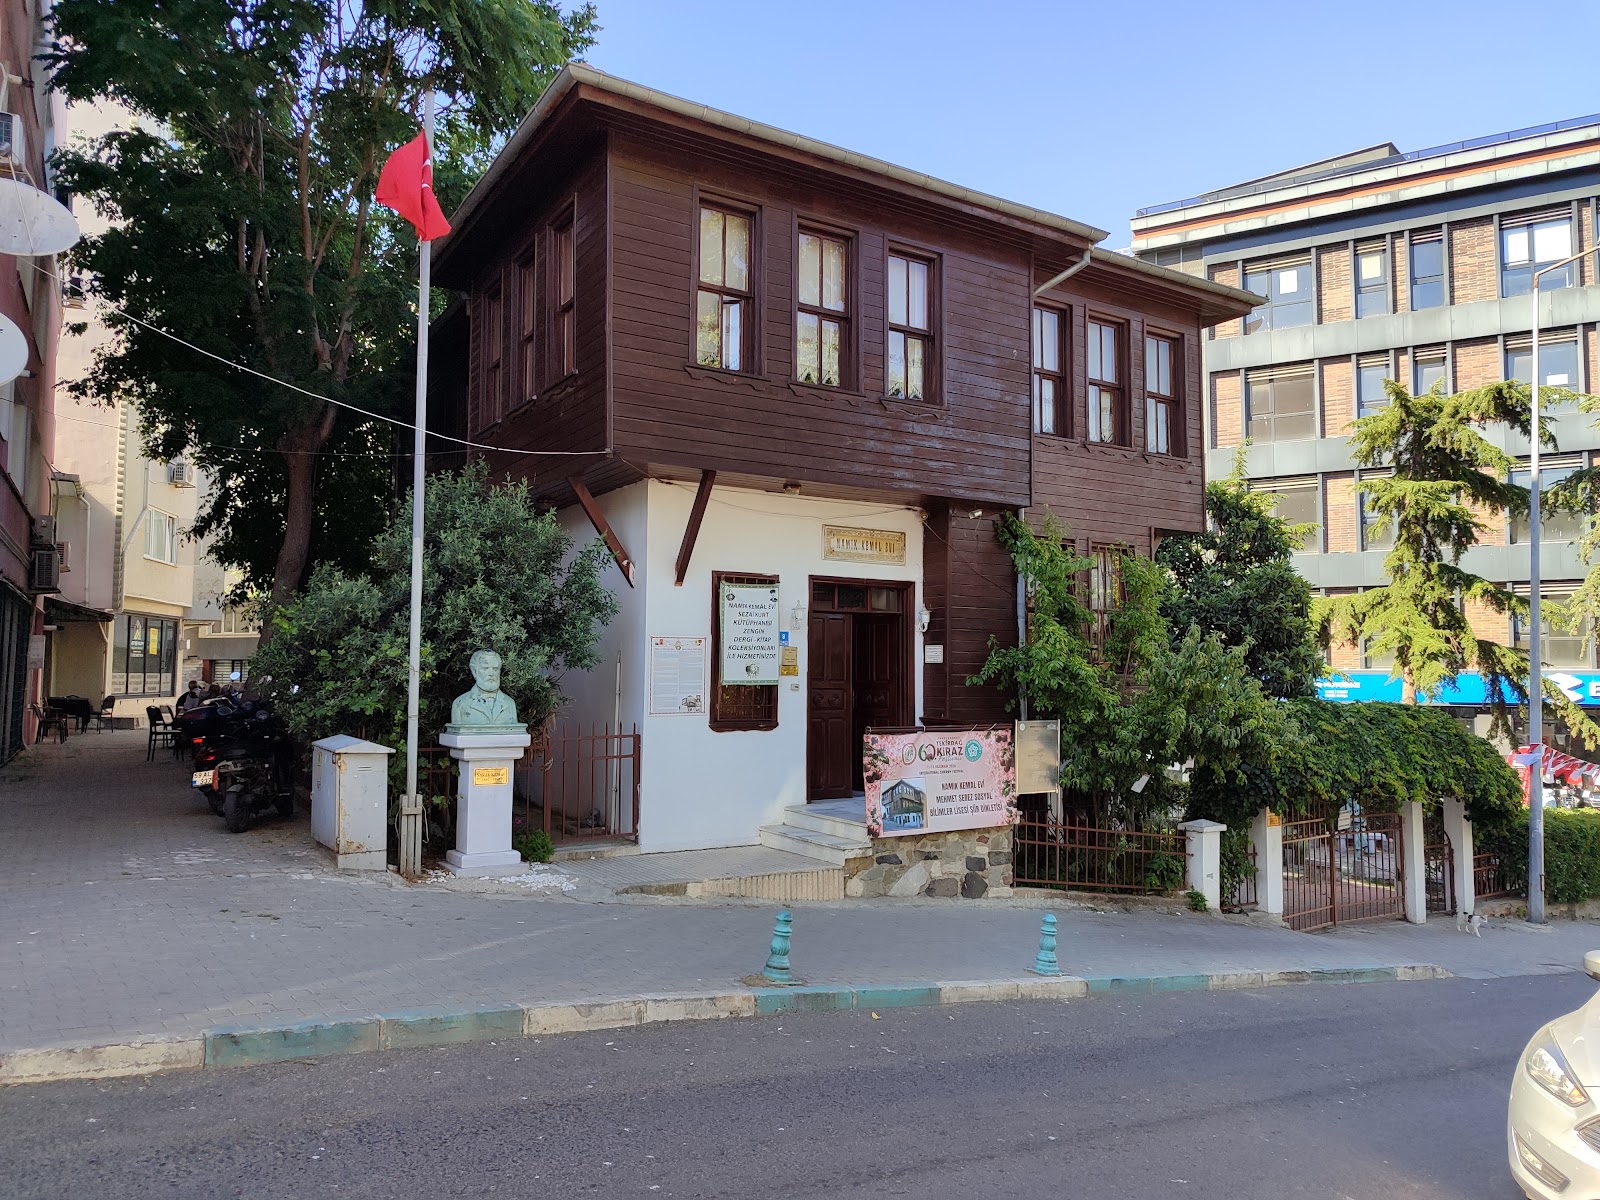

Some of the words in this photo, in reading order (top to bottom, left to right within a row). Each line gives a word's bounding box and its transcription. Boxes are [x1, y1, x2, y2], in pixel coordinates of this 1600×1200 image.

[836, 538, 858, 551] NAMIK
[936, 746, 964, 756] KİRAZ
[941, 782, 958, 791] NAMIK
[936, 794, 957, 804] MEHMET
[974, 792, 993, 801] SOSYAL
[929, 807, 954, 817] BİLİMLER
